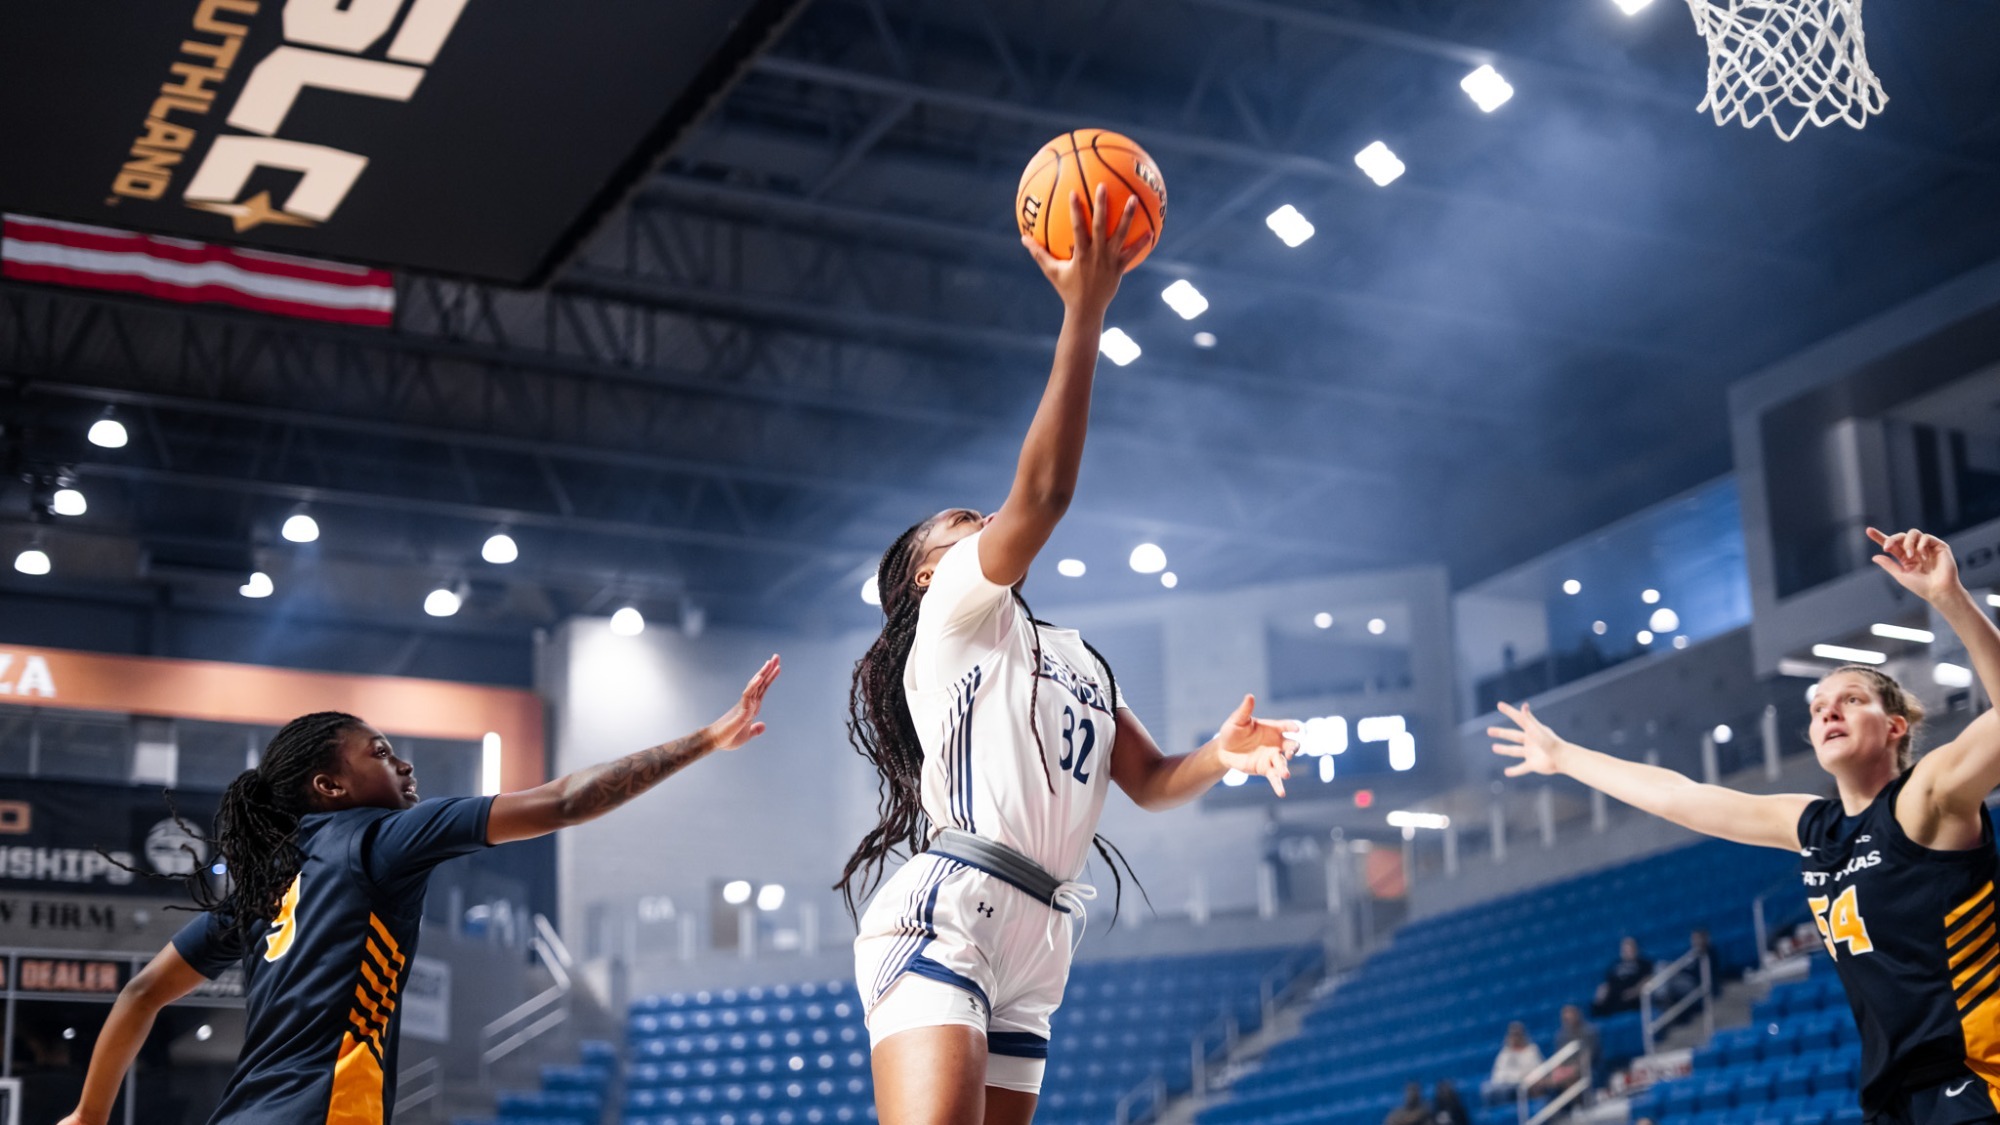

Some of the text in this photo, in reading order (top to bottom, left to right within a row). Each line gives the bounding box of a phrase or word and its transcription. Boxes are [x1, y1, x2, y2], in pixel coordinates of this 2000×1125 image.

[111, 0, 260, 200] UTHLAND
[1059, 705, 1096, 785] 32
[0, 846, 134, 886] SHIPS
[29, 900, 116, 932] FIRM
[1807, 884, 1874, 963] 54
[21, 959, 117, 990] DEALER
